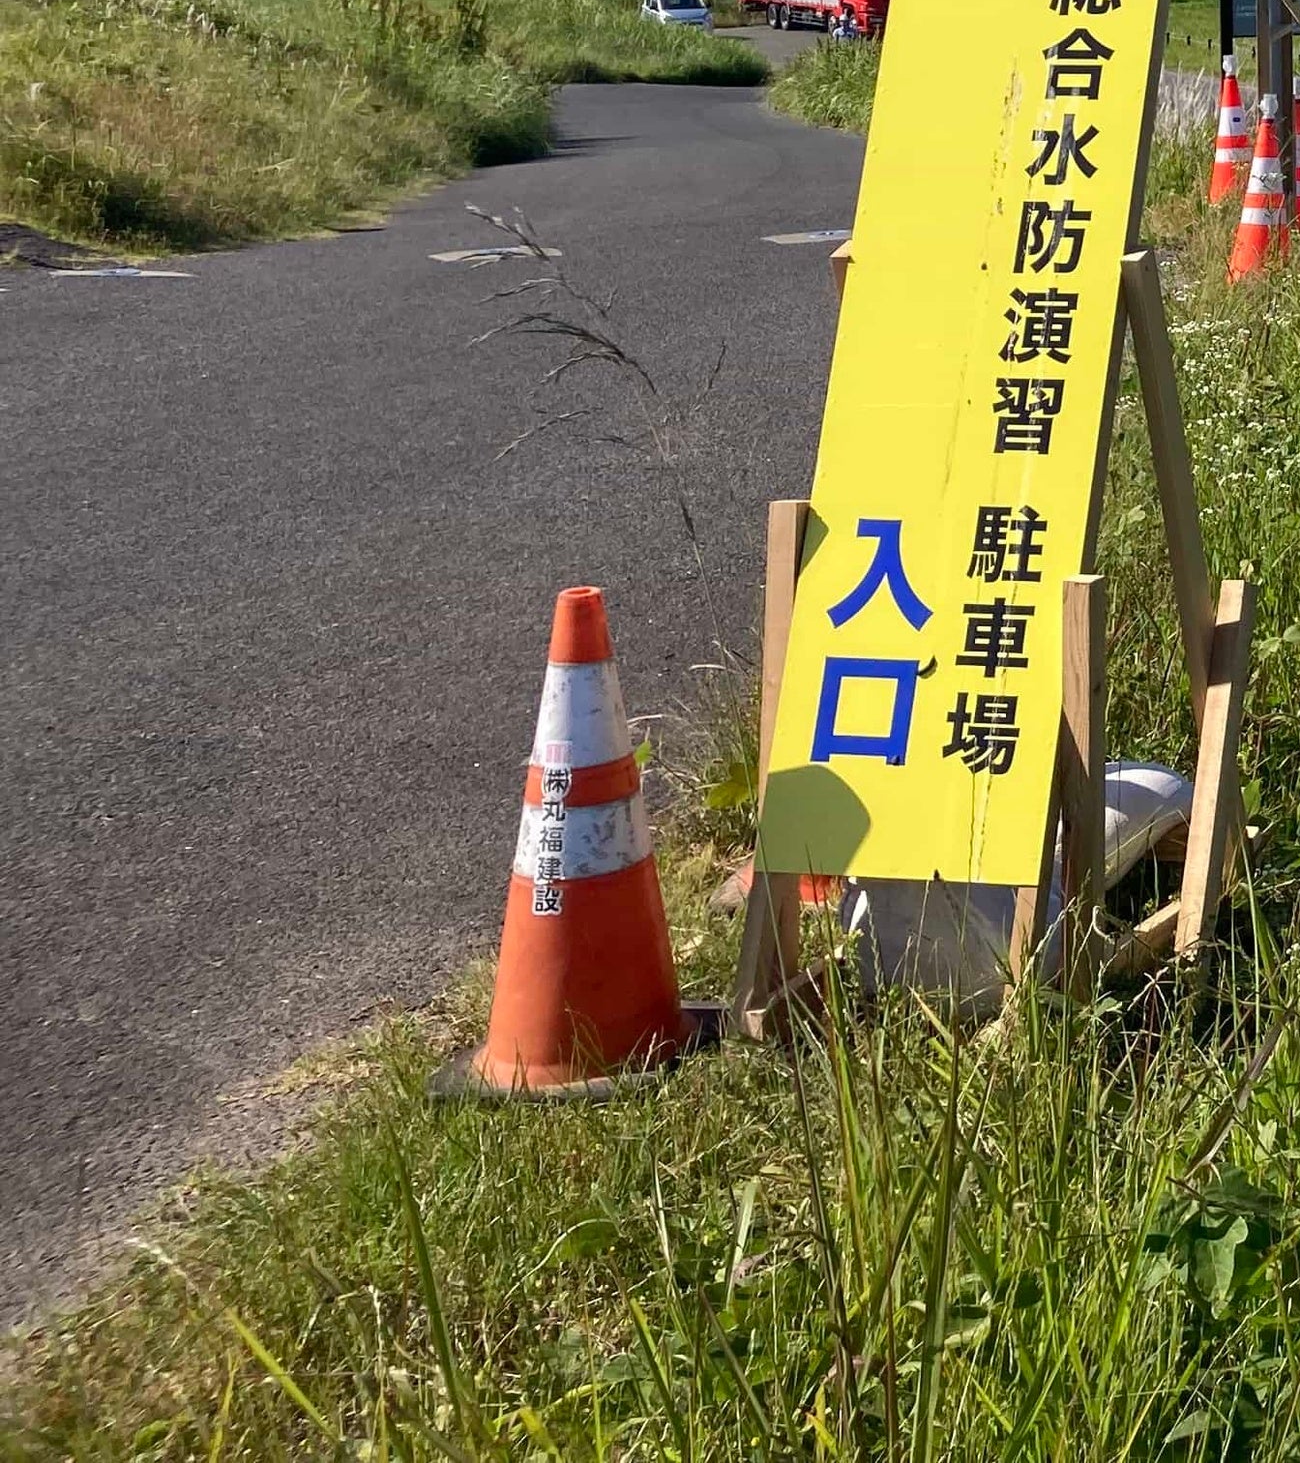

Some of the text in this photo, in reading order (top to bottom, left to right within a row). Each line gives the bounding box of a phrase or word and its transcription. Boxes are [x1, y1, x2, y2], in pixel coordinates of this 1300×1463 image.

[810, 519, 932, 766] 入口
[941, 504, 1045, 775] 駐車場
